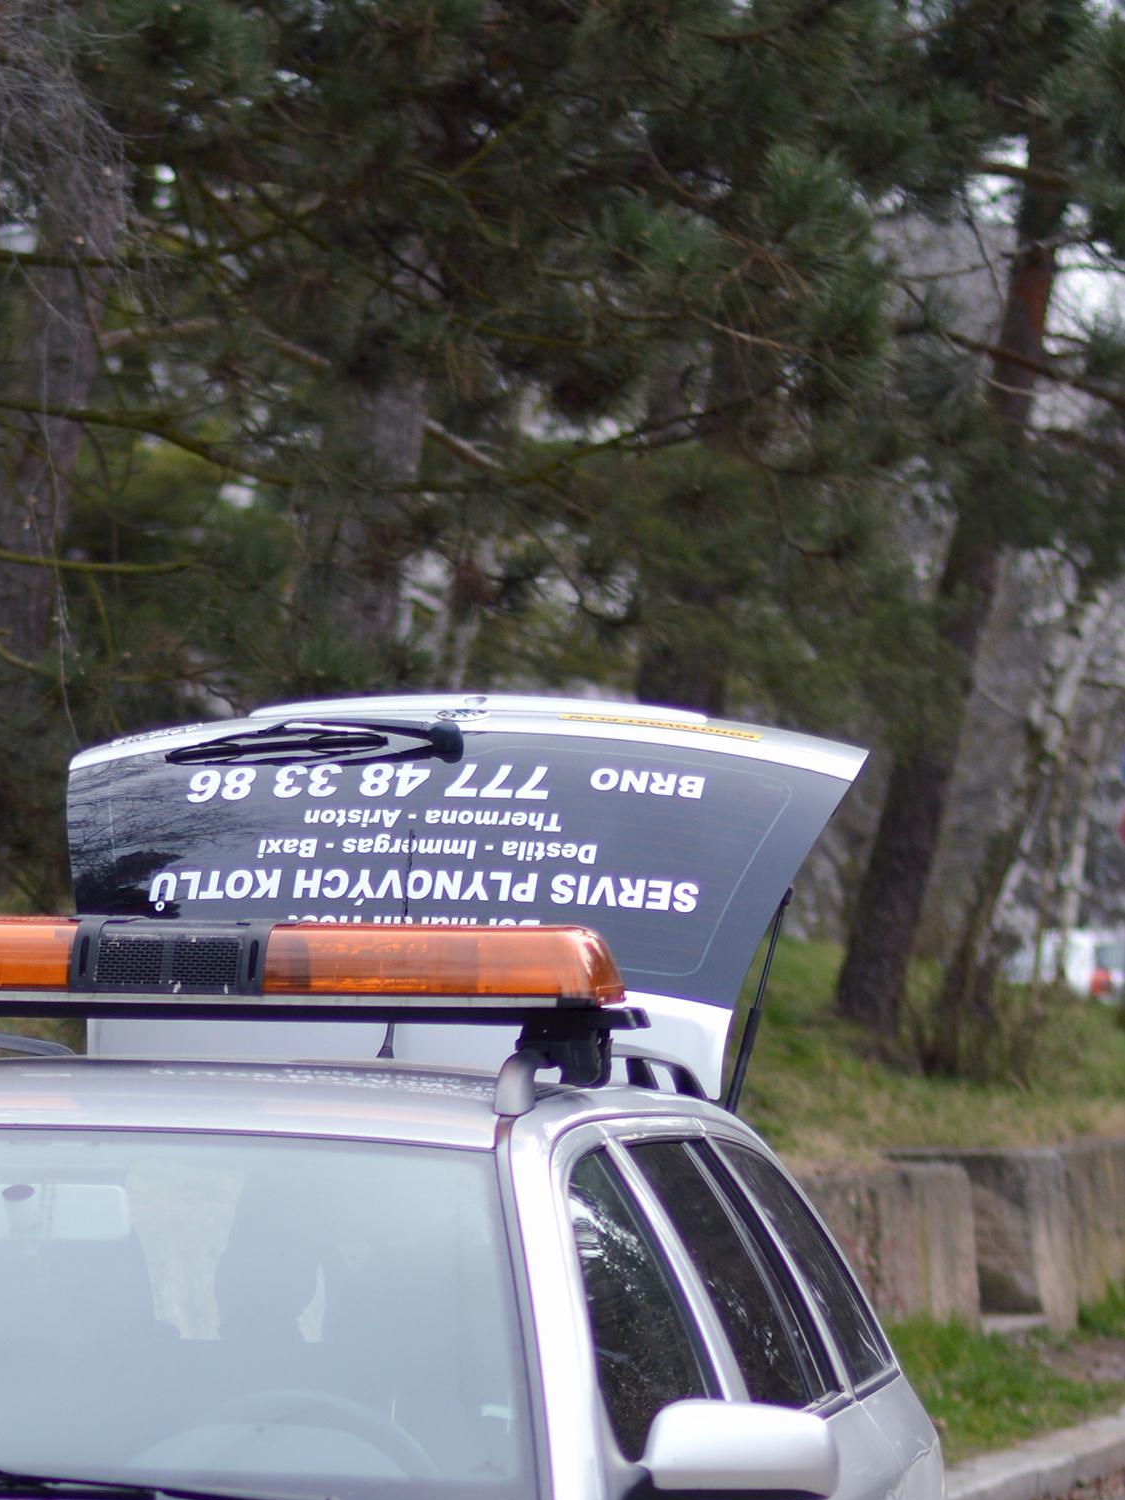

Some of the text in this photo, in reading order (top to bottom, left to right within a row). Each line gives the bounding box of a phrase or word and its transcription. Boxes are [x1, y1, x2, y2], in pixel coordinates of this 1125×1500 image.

[185, 762, 707, 804] BRNO 777 48 33 86
[303, 808, 403, 829] Ariston
[424, 808, 563, 833] Thermona
[257, 838, 319, 859] Baxi
[341, 833, 477, 860] Immergas
[501, 840, 598, 866] Destila
[148, 868, 700, 914] SERVIS PLYNOVÝCH KOTLŮ
